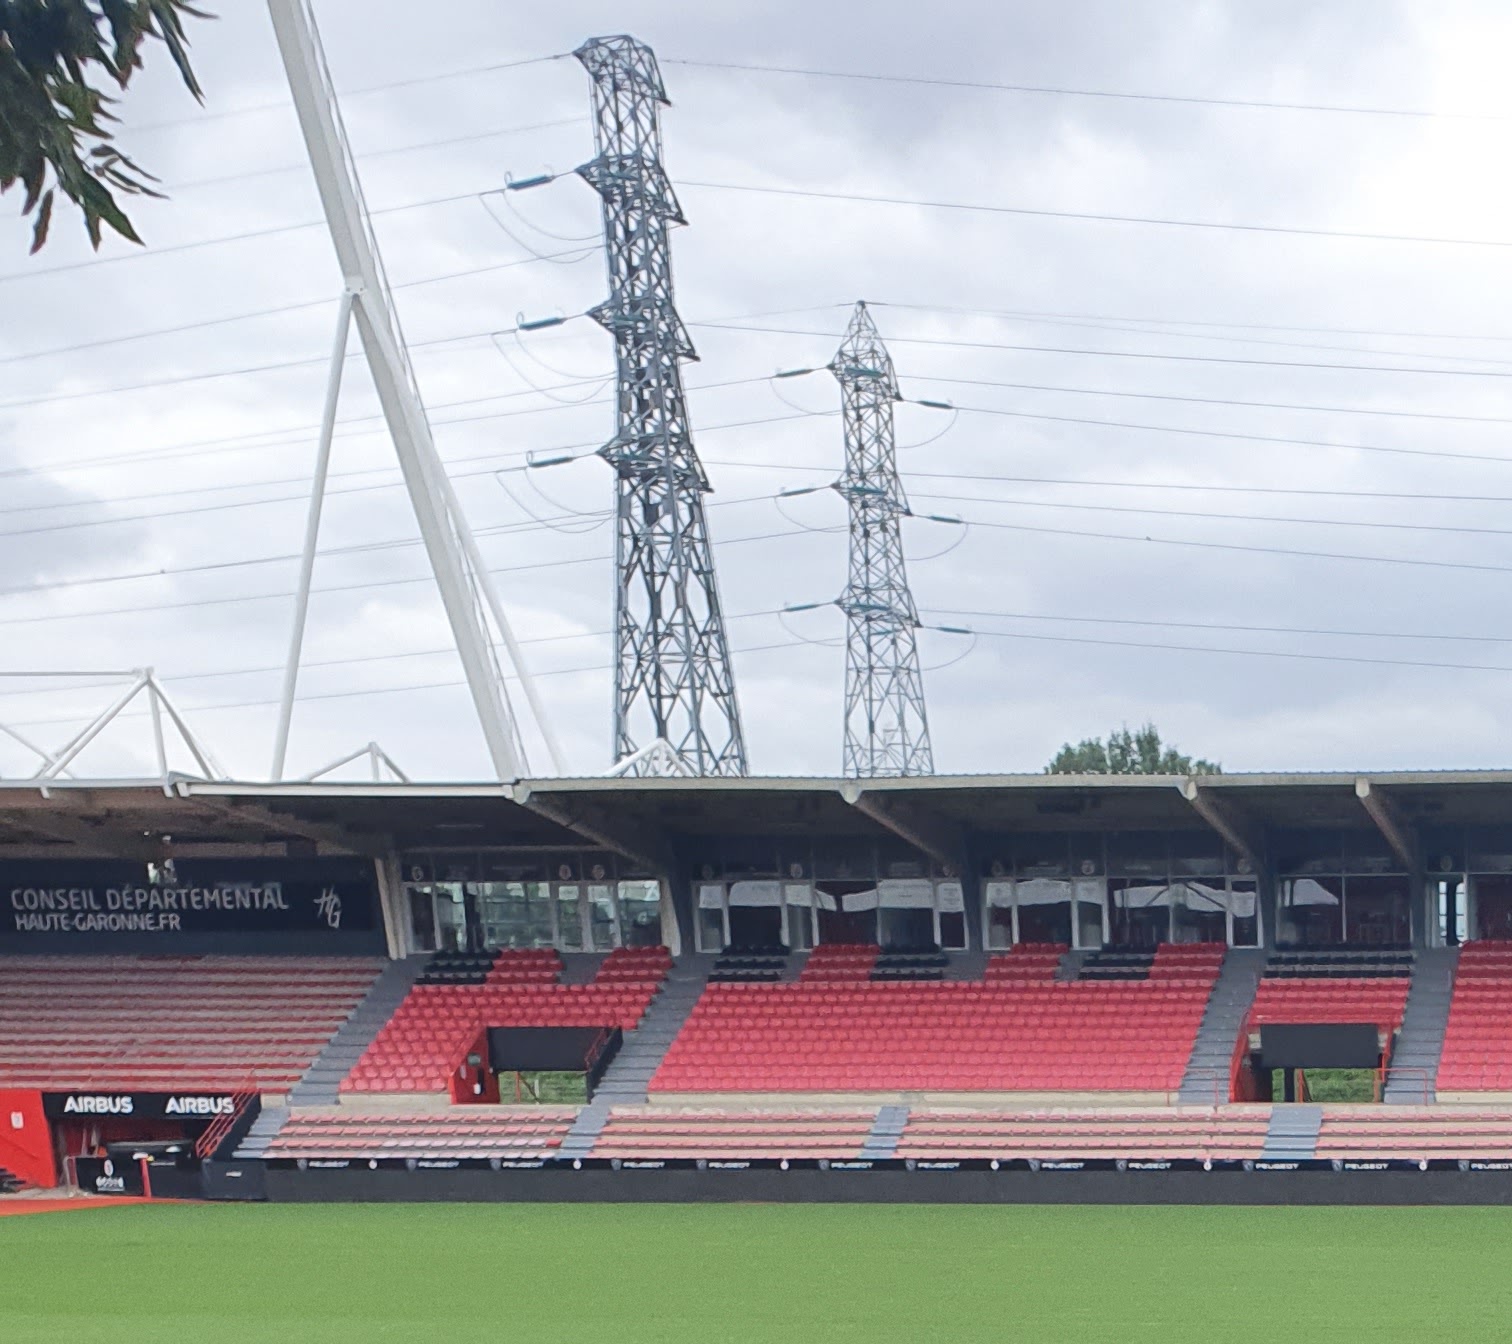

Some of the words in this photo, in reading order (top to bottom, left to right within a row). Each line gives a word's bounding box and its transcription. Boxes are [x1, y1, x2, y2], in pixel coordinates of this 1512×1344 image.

[11, 888, 101, 910] CONSEIL
[107, 884, 289, 910] DÉPARTEMENTAL
[14, 912, 181, 931] HAUTE-GARONNE.FR
[64, 1096, 134, 1114] AIRBUS
[165, 1096, 235, 1114] AIRBUS
